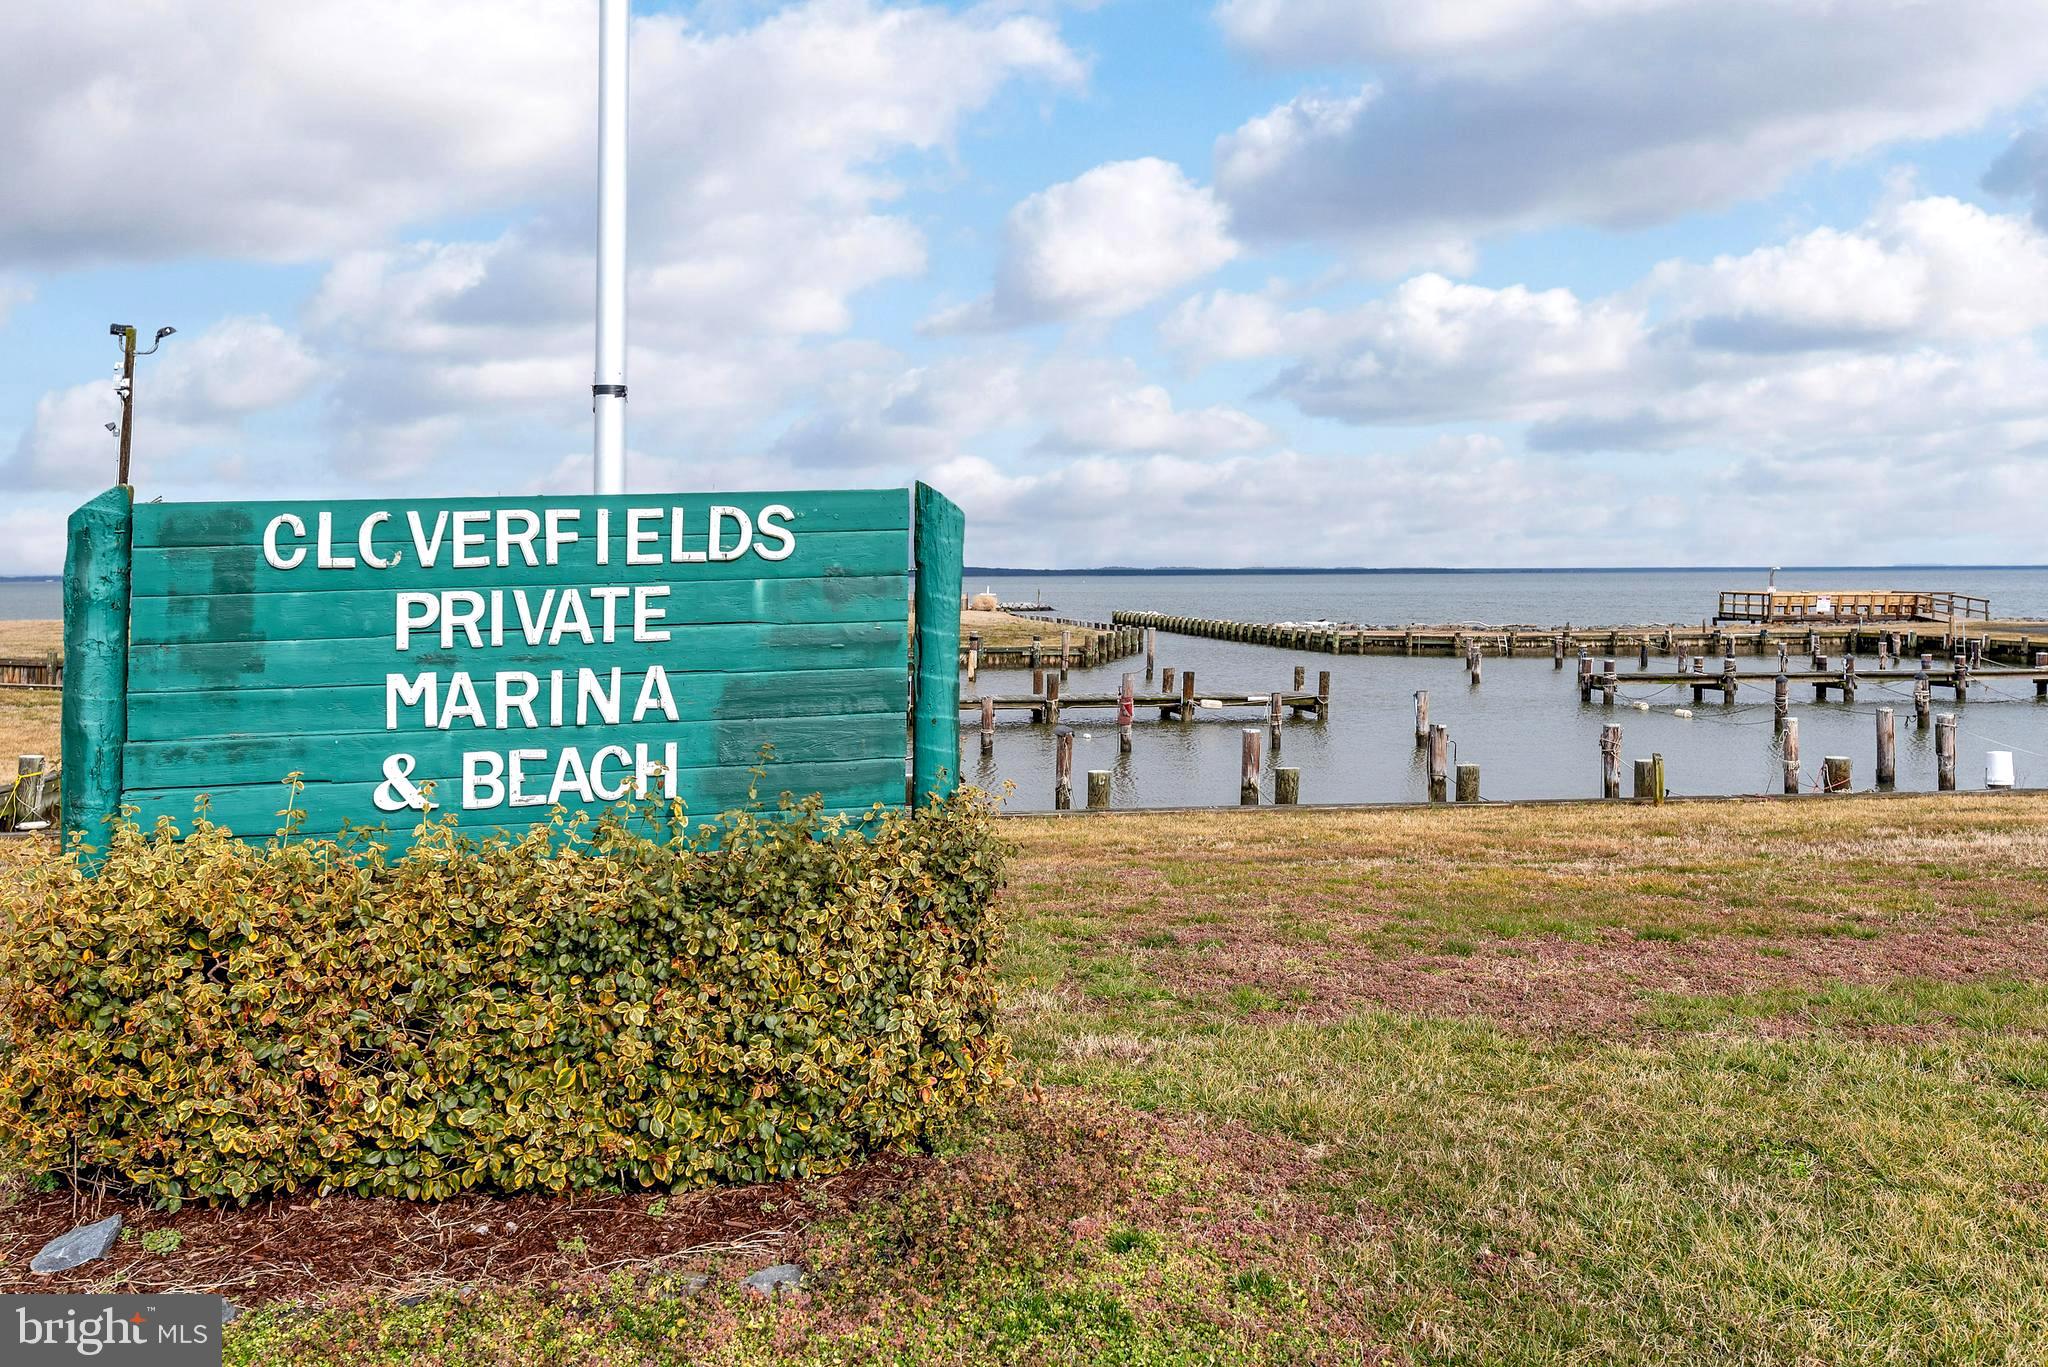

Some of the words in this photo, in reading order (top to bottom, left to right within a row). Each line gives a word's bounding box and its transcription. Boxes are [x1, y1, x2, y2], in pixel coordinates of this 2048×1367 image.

[396, 586, 670, 650] PRIVATE
[387, 666, 679, 729] MARINA
[374, 754, 439, 810] &
[463, 742, 677, 809] BEACH
